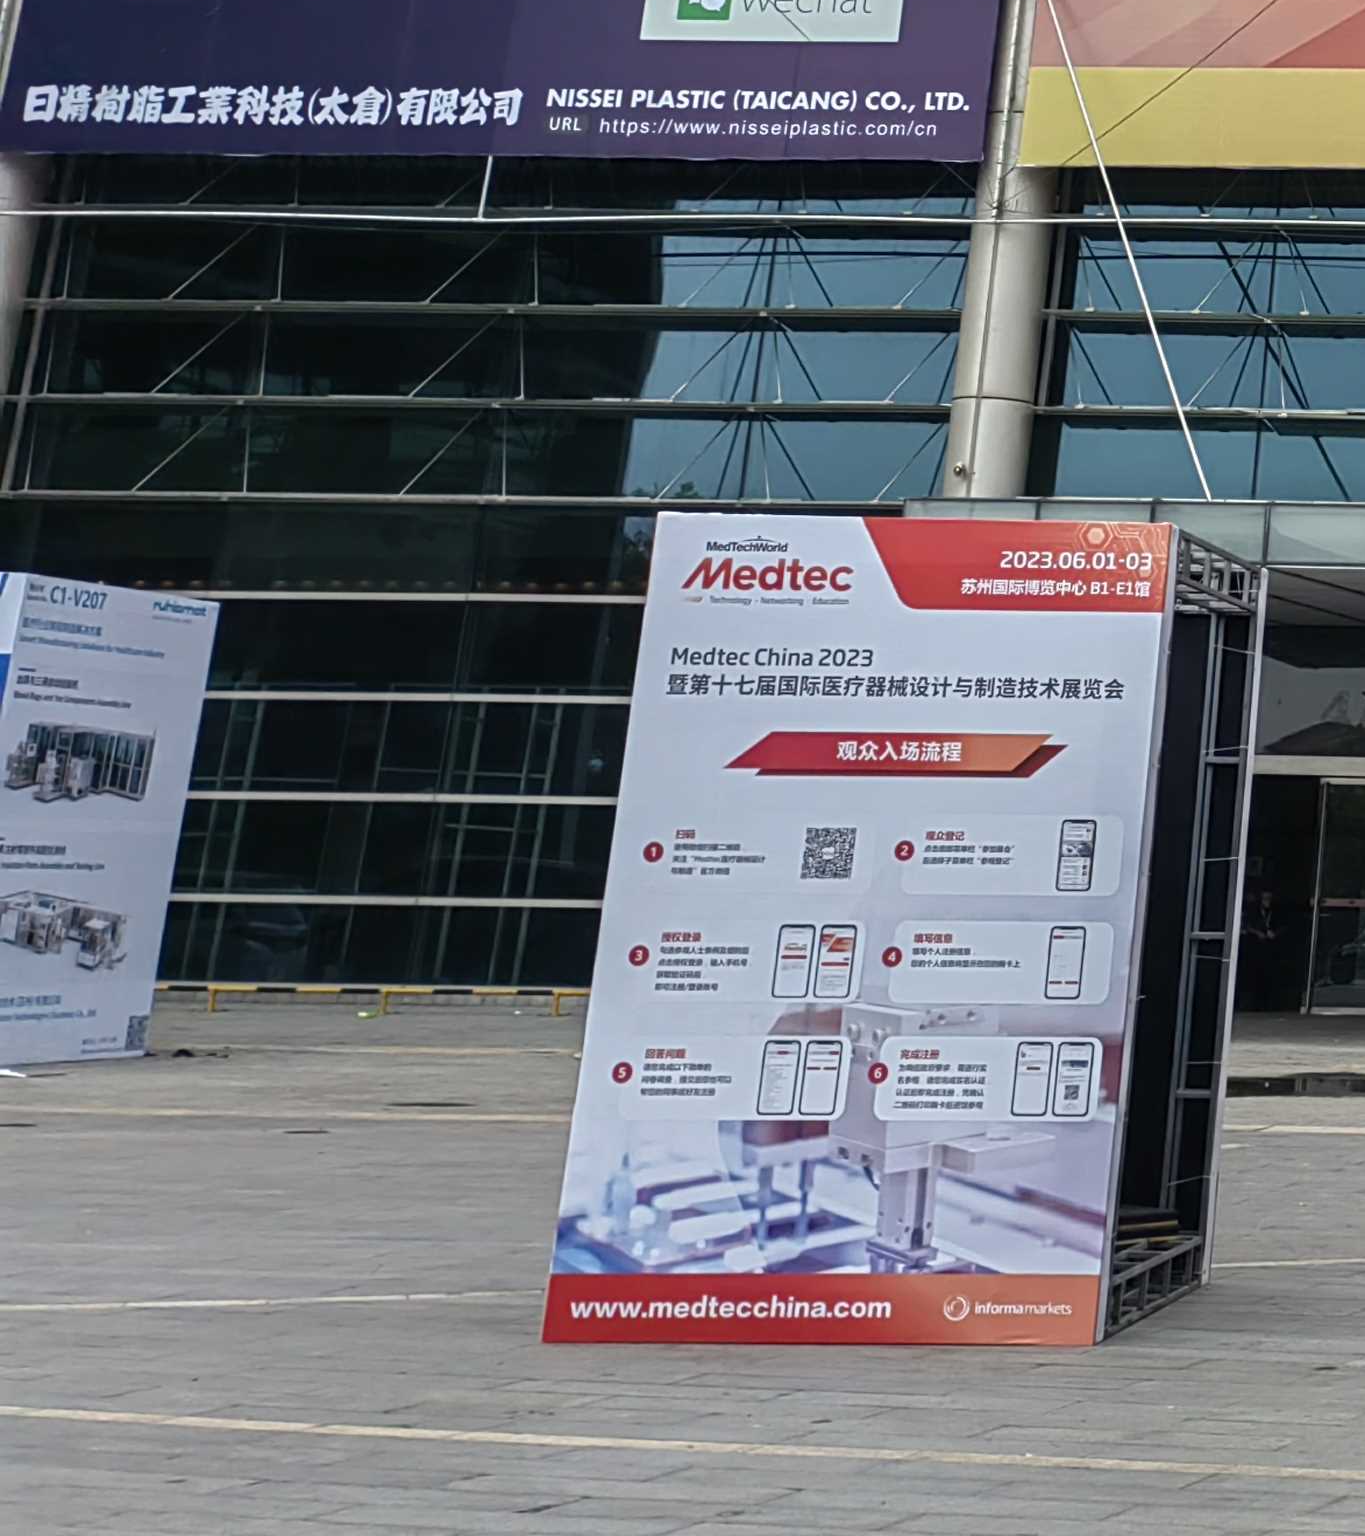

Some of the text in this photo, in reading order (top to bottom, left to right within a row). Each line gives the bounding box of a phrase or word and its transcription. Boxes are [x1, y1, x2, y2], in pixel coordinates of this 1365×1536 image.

[546, 88, 970, 114] NISSEI PLASTIC (TAICANG) CO., LTD.
[549, 116, 937, 138] URL https://www.nisseiplastic.com/cn
[706, 541, 788, 553] MedTechWorld
[1000, 551, 1152, 570] 2023.06.01-03
[681, 557, 854, 592] Medtec
[50, 586, 108, 610] C1-V207
[961, 579, 1151, 598] 苏州国际博览中心 B1-E1馆
[671, 647, 874, 667] Medtec China 2023
[666, 673, 1125, 700] 暨第十七届国际医疗器械设计与制造技术展览会
[836, 741, 962, 763] 观众入场流程
[570, 1295, 892, 1319] www.medtecchina.com
